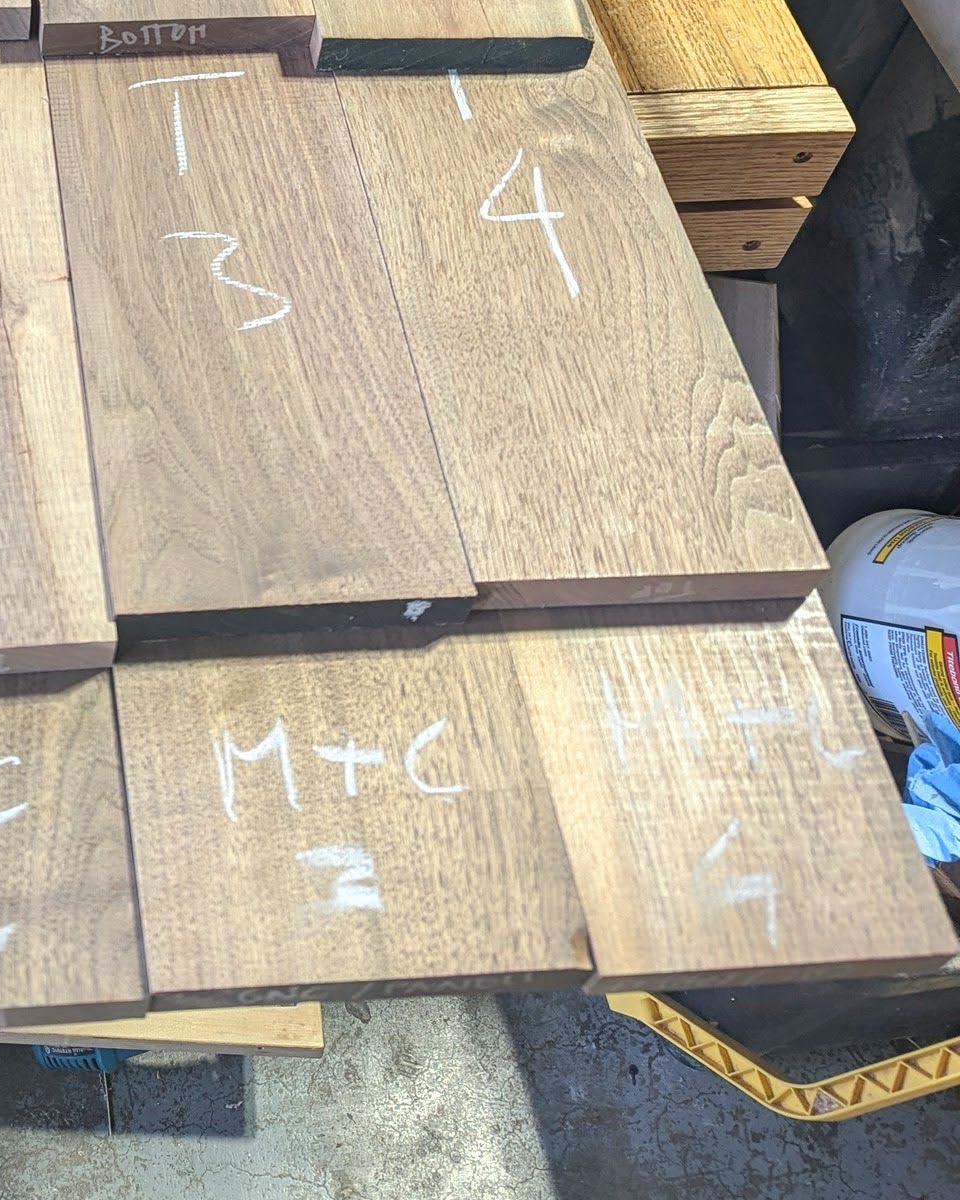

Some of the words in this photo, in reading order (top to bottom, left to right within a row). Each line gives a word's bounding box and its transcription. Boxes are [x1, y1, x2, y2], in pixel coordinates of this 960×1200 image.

[128, 71, 246, 176] T
[479, 147, 581, 298] 4
[160, 231, 292, 331] 3
